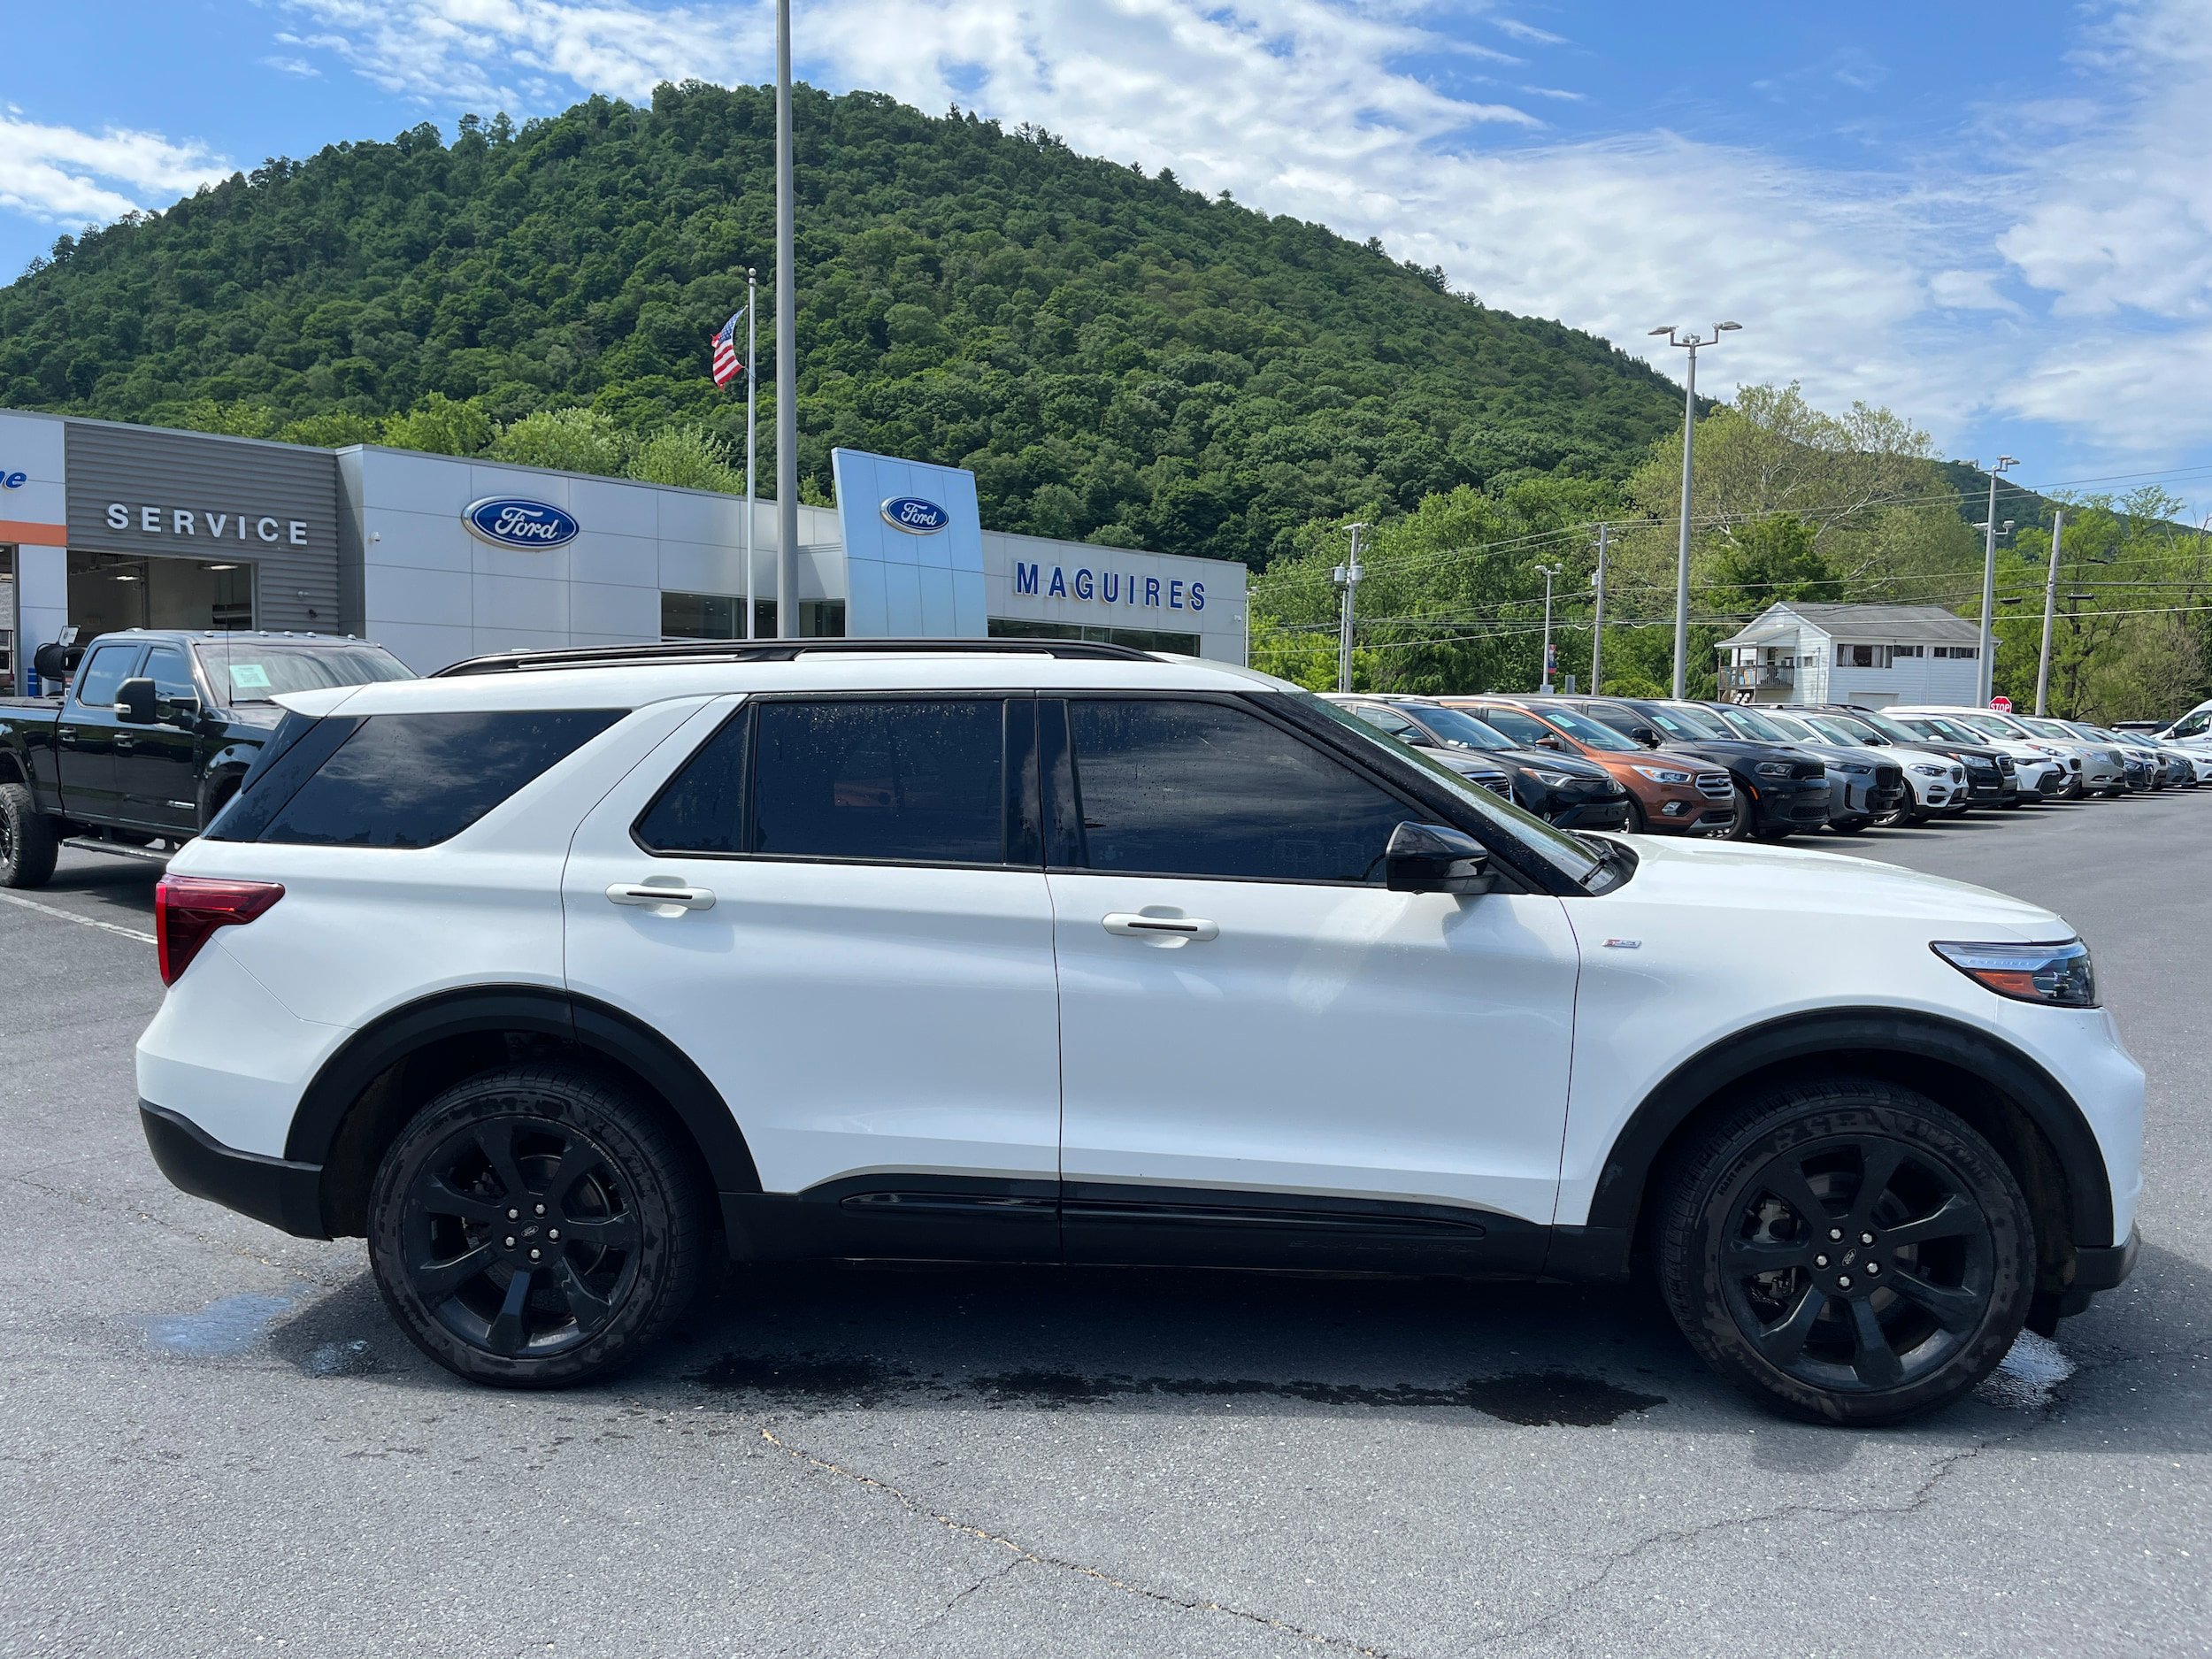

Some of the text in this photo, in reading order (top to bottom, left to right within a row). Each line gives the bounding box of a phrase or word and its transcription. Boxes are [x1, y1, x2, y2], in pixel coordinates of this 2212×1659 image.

[106, 503, 309, 546] SERVICE
[495, 506, 560, 540] Ford
[901, 502, 937, 526] Ford
[1017, 562, 1206, 612] MAGUIRES
[1991, 703, 2010, 712] STOP
